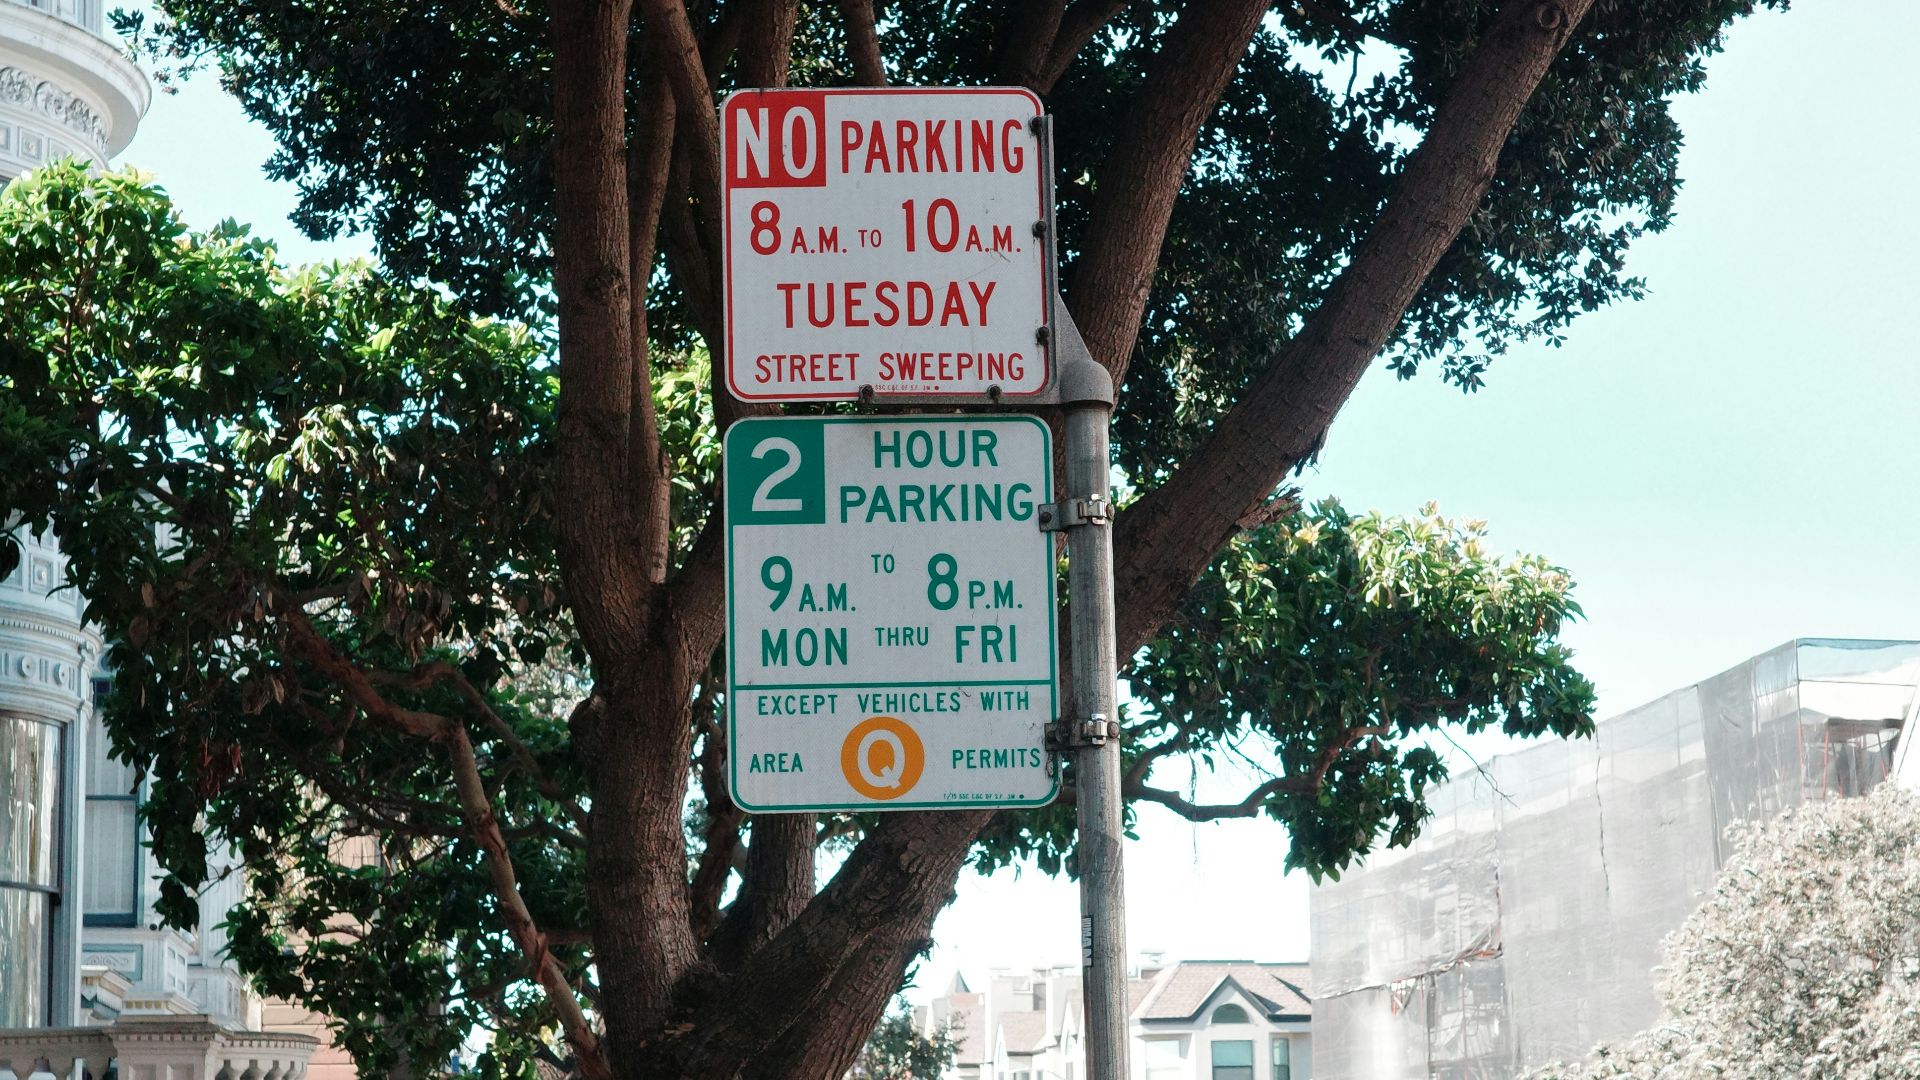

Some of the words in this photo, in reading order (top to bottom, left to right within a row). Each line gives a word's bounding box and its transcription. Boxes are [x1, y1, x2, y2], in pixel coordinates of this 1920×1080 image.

[736, 106, 817, 179] NO
[841, 119, 1024, 173] PARKING
[858, 229, 882, 248] TO
[776, 281, 995, 328] TUESDAY
[755, 353, 859, 384] STREET
[880, 352, 1024, 381] SWEEPING
[751, 437, 802, 512] 2
[874, 429, 999, 469] HOUR
[839, 482, 1034, 524] PARKING
[870, 553, 895, 574] TO
[760, 627, 848, 668] MON
[875, 626, 929, 648] THRU
[954, 624, 1018, 664] FRI
[757, 693, 838, 717] EXCEPT
[857, 690, 960, 714] VEHICLES
[980, 690, 1030, 712] WITH
[749, 752, 804, 774] AREA
[857, 728, 906, 790] Q
[951, 747, 1041, 769] PERMITS
